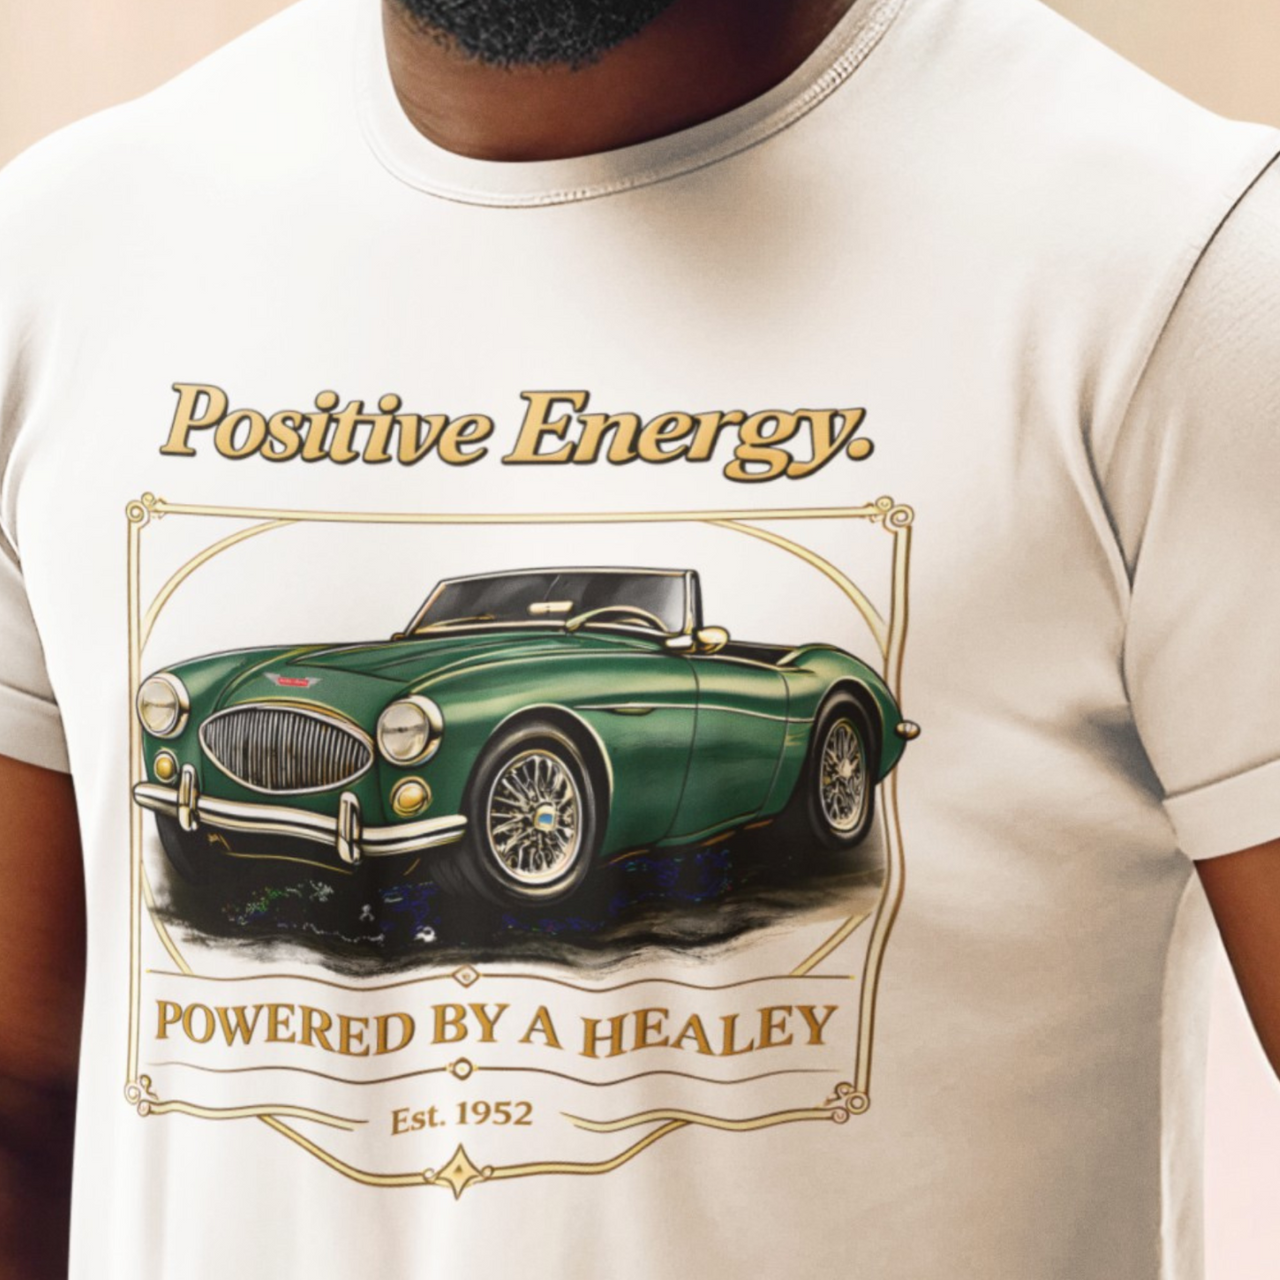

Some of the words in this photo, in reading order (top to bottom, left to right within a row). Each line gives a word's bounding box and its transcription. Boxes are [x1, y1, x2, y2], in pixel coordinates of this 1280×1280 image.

[160, 383, 494, 465] Positive
[501, 389, 875, 483] Energy.
[155, 1000, 414, 1058] POWERED
[431, 1003, 510, 1043] BY
[520, 1003, 564, 1051] A
[579, 1003, 839, 1059] HEALEY
[390, 1107, 446, 1136] Est.
[455, 1100, 534, 1127] 1952
